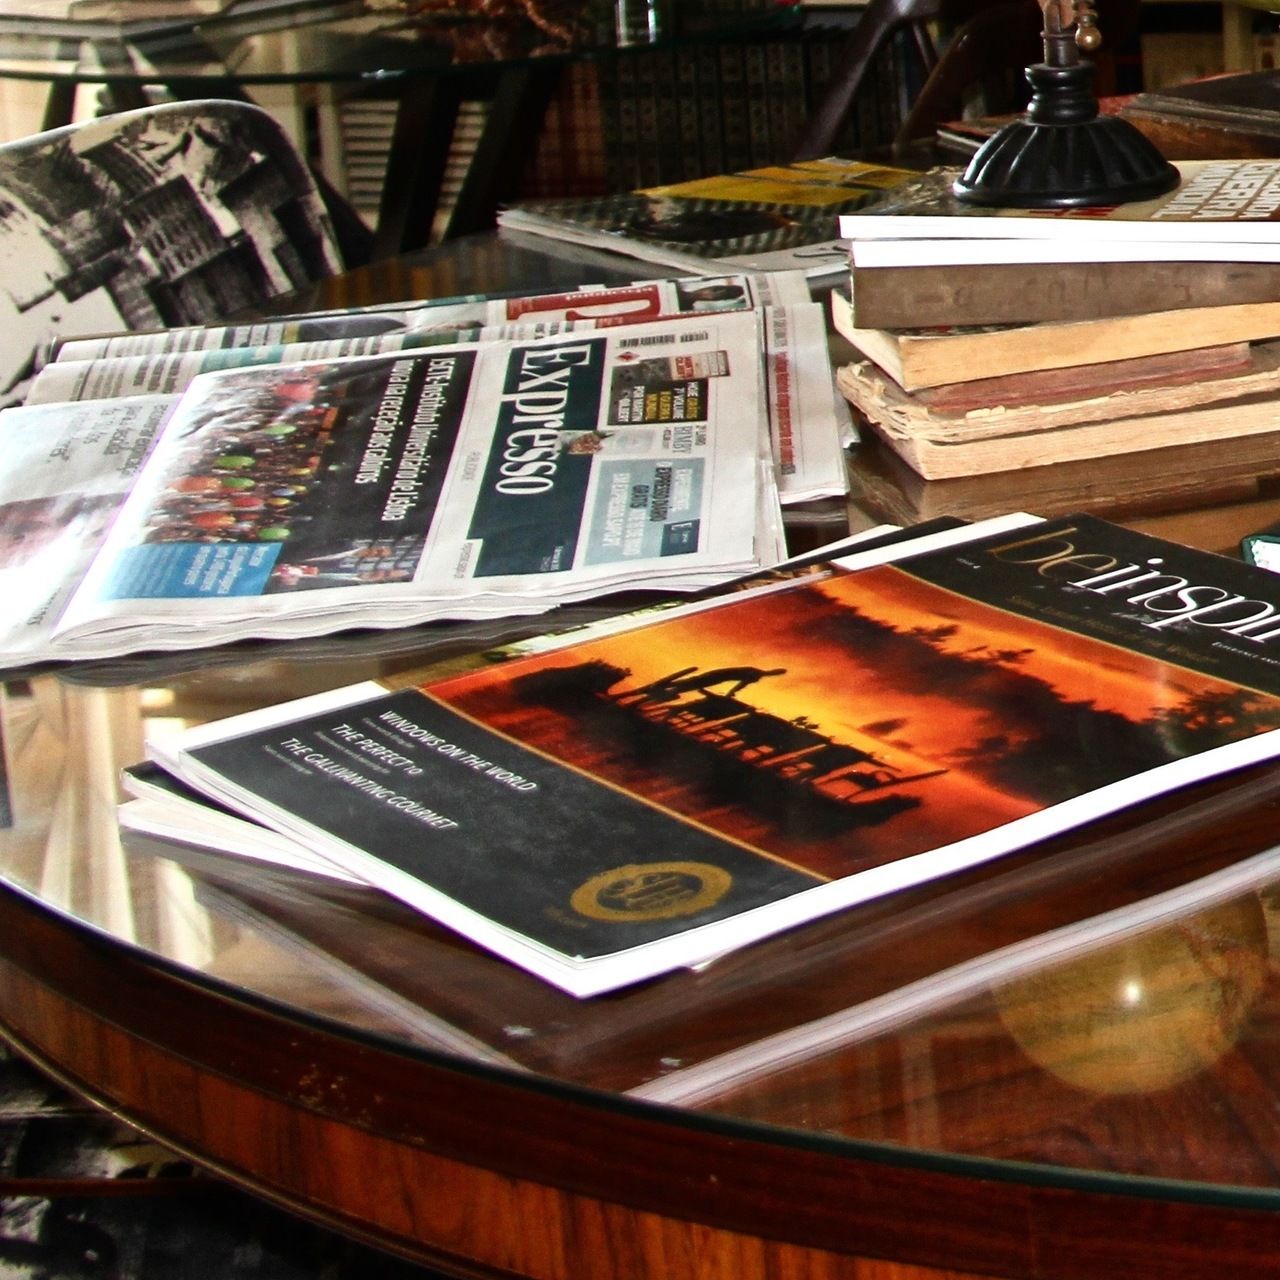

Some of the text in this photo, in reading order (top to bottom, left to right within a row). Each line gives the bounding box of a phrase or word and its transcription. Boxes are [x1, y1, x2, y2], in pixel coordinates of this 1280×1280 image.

[495, 343, 592, 495] Expresso
[381, 491, 418, 521] Lisboa
[279, 737, 308, 757] THE
[303, 752, 396, 800] GALLIVANTING
[387, 794, 460, 830] GOURMET
[330, 723, 359, 743] THE
[355, 737, 413, 768] PERFECT
[378, 710, 538, 792] WINDOWS ON THE WORLD
